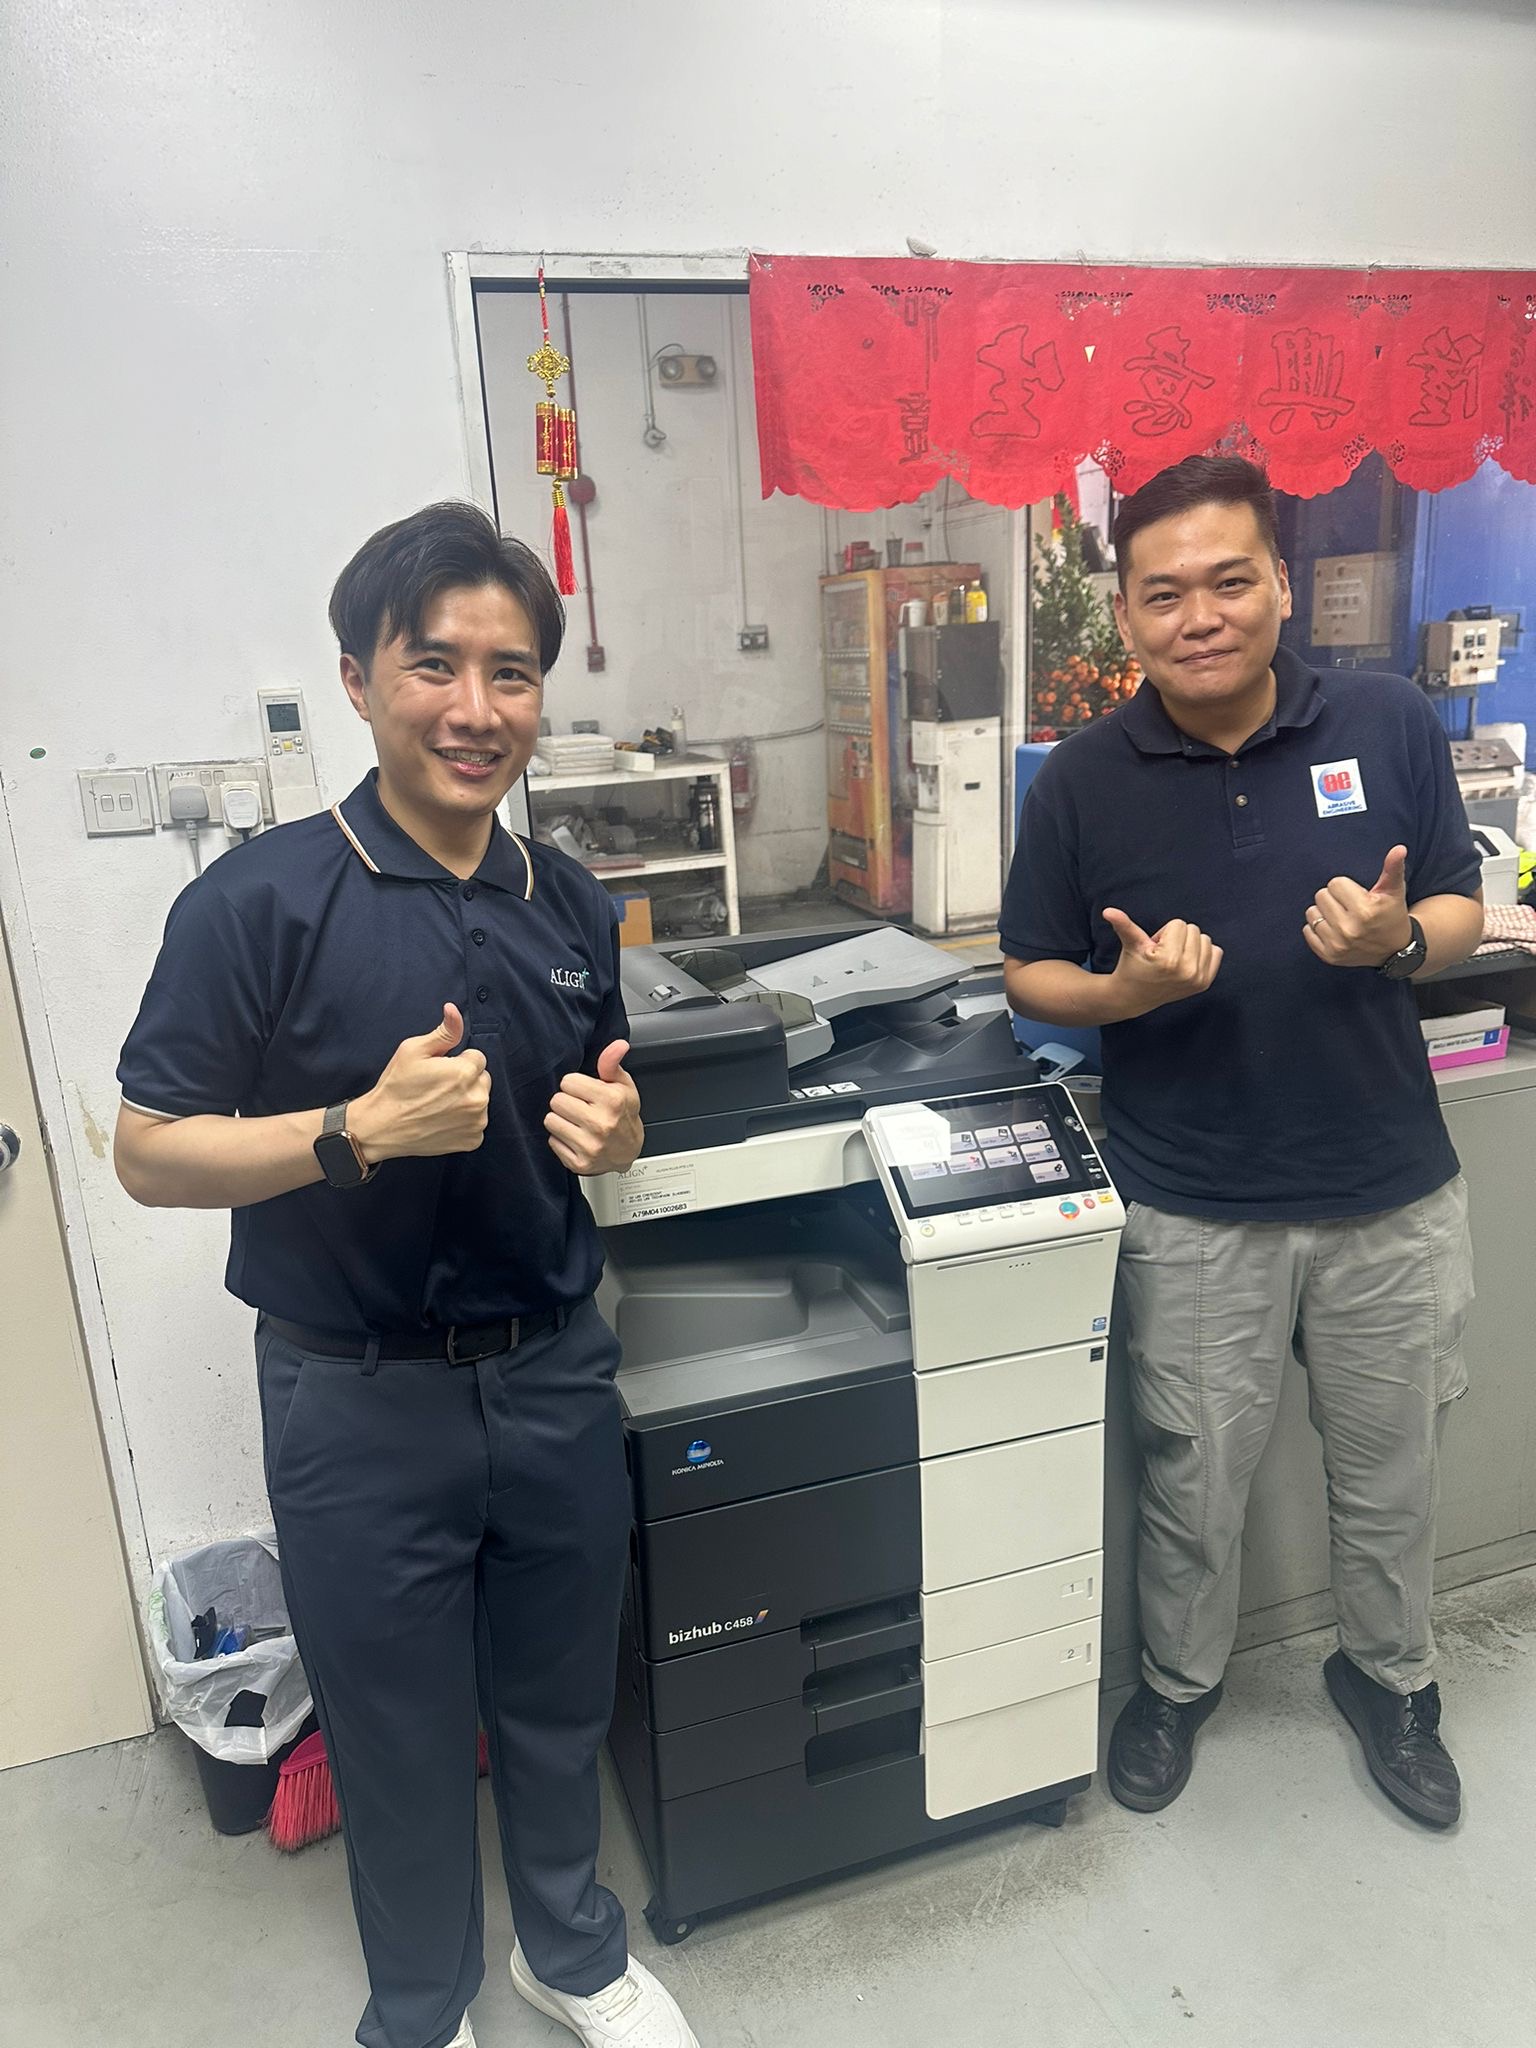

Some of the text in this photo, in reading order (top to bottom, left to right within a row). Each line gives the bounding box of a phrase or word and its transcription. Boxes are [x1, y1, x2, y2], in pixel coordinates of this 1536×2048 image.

[1322, 805, 1363, 815] ENGINEERING
[1328, 801, 1356, 809] ABRASIVE
[671, 1459, 725, 1476] KONICA MINOLTA
[668, 1621, 723, 1645] bizhub
[1067, 1649, 1074, 1659] 2
